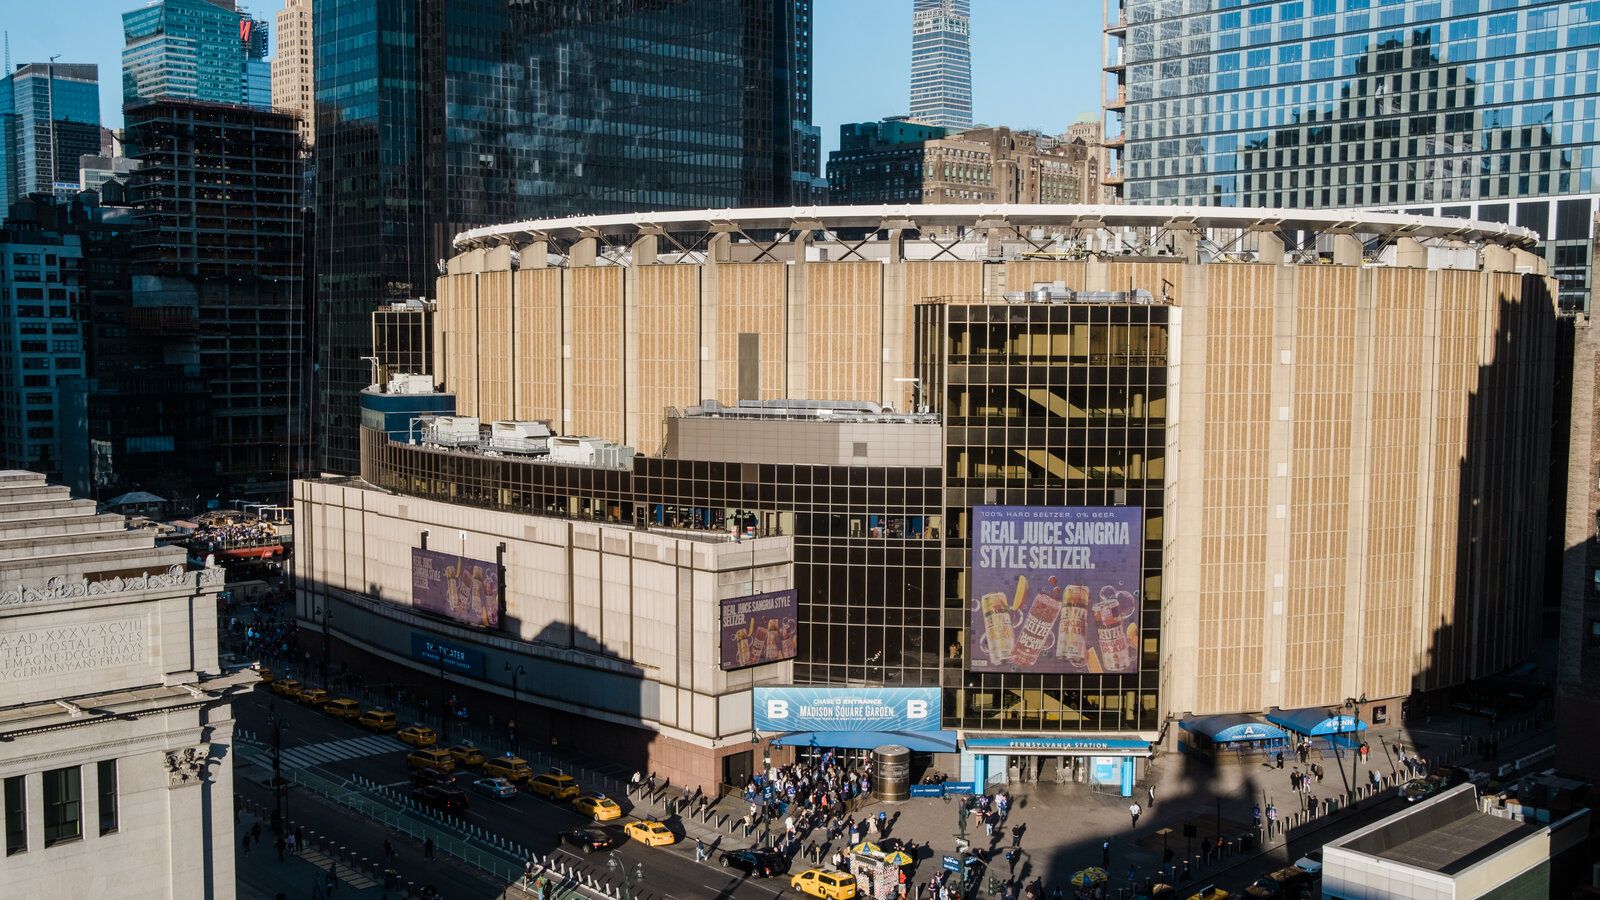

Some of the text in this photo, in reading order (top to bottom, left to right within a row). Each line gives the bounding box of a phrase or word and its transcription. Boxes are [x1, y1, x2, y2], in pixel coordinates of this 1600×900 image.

[980, 521, 1130, 545] REAL JUICE SANGRIA
[980, 545, 1095, 569] STYLE SELTZER.
[723, 604, 737, 617] REAL
[738, 602, 752, 614] JUICE
[752, 598, 774, 612] SANGRIA
[774, 596, 791, 609] STYLE
[723, 613, 746, 628] SELTZER.
[17, 633, 38, 646] AD
[41, 638, 92, 654] POSTAL
[100, 631, 143, 645] TAXES
[65, 648, 97, 661] DCCC
[102, 642, 144, 656] RELAYS
[13, 660, 72, 678] GERMANY
[75, 658, 97, 670] AND
[100, 653, 143, 667] FRANCE
[767, 699, 789, 719] B
[800, 705, 894, 717] MADISON SQUARE GARDEN
[907, 699, 928, 719] B
[1244, 725, 1255, 735] A
[1009, 741, 1071, 749] PENNSYLVANIA
